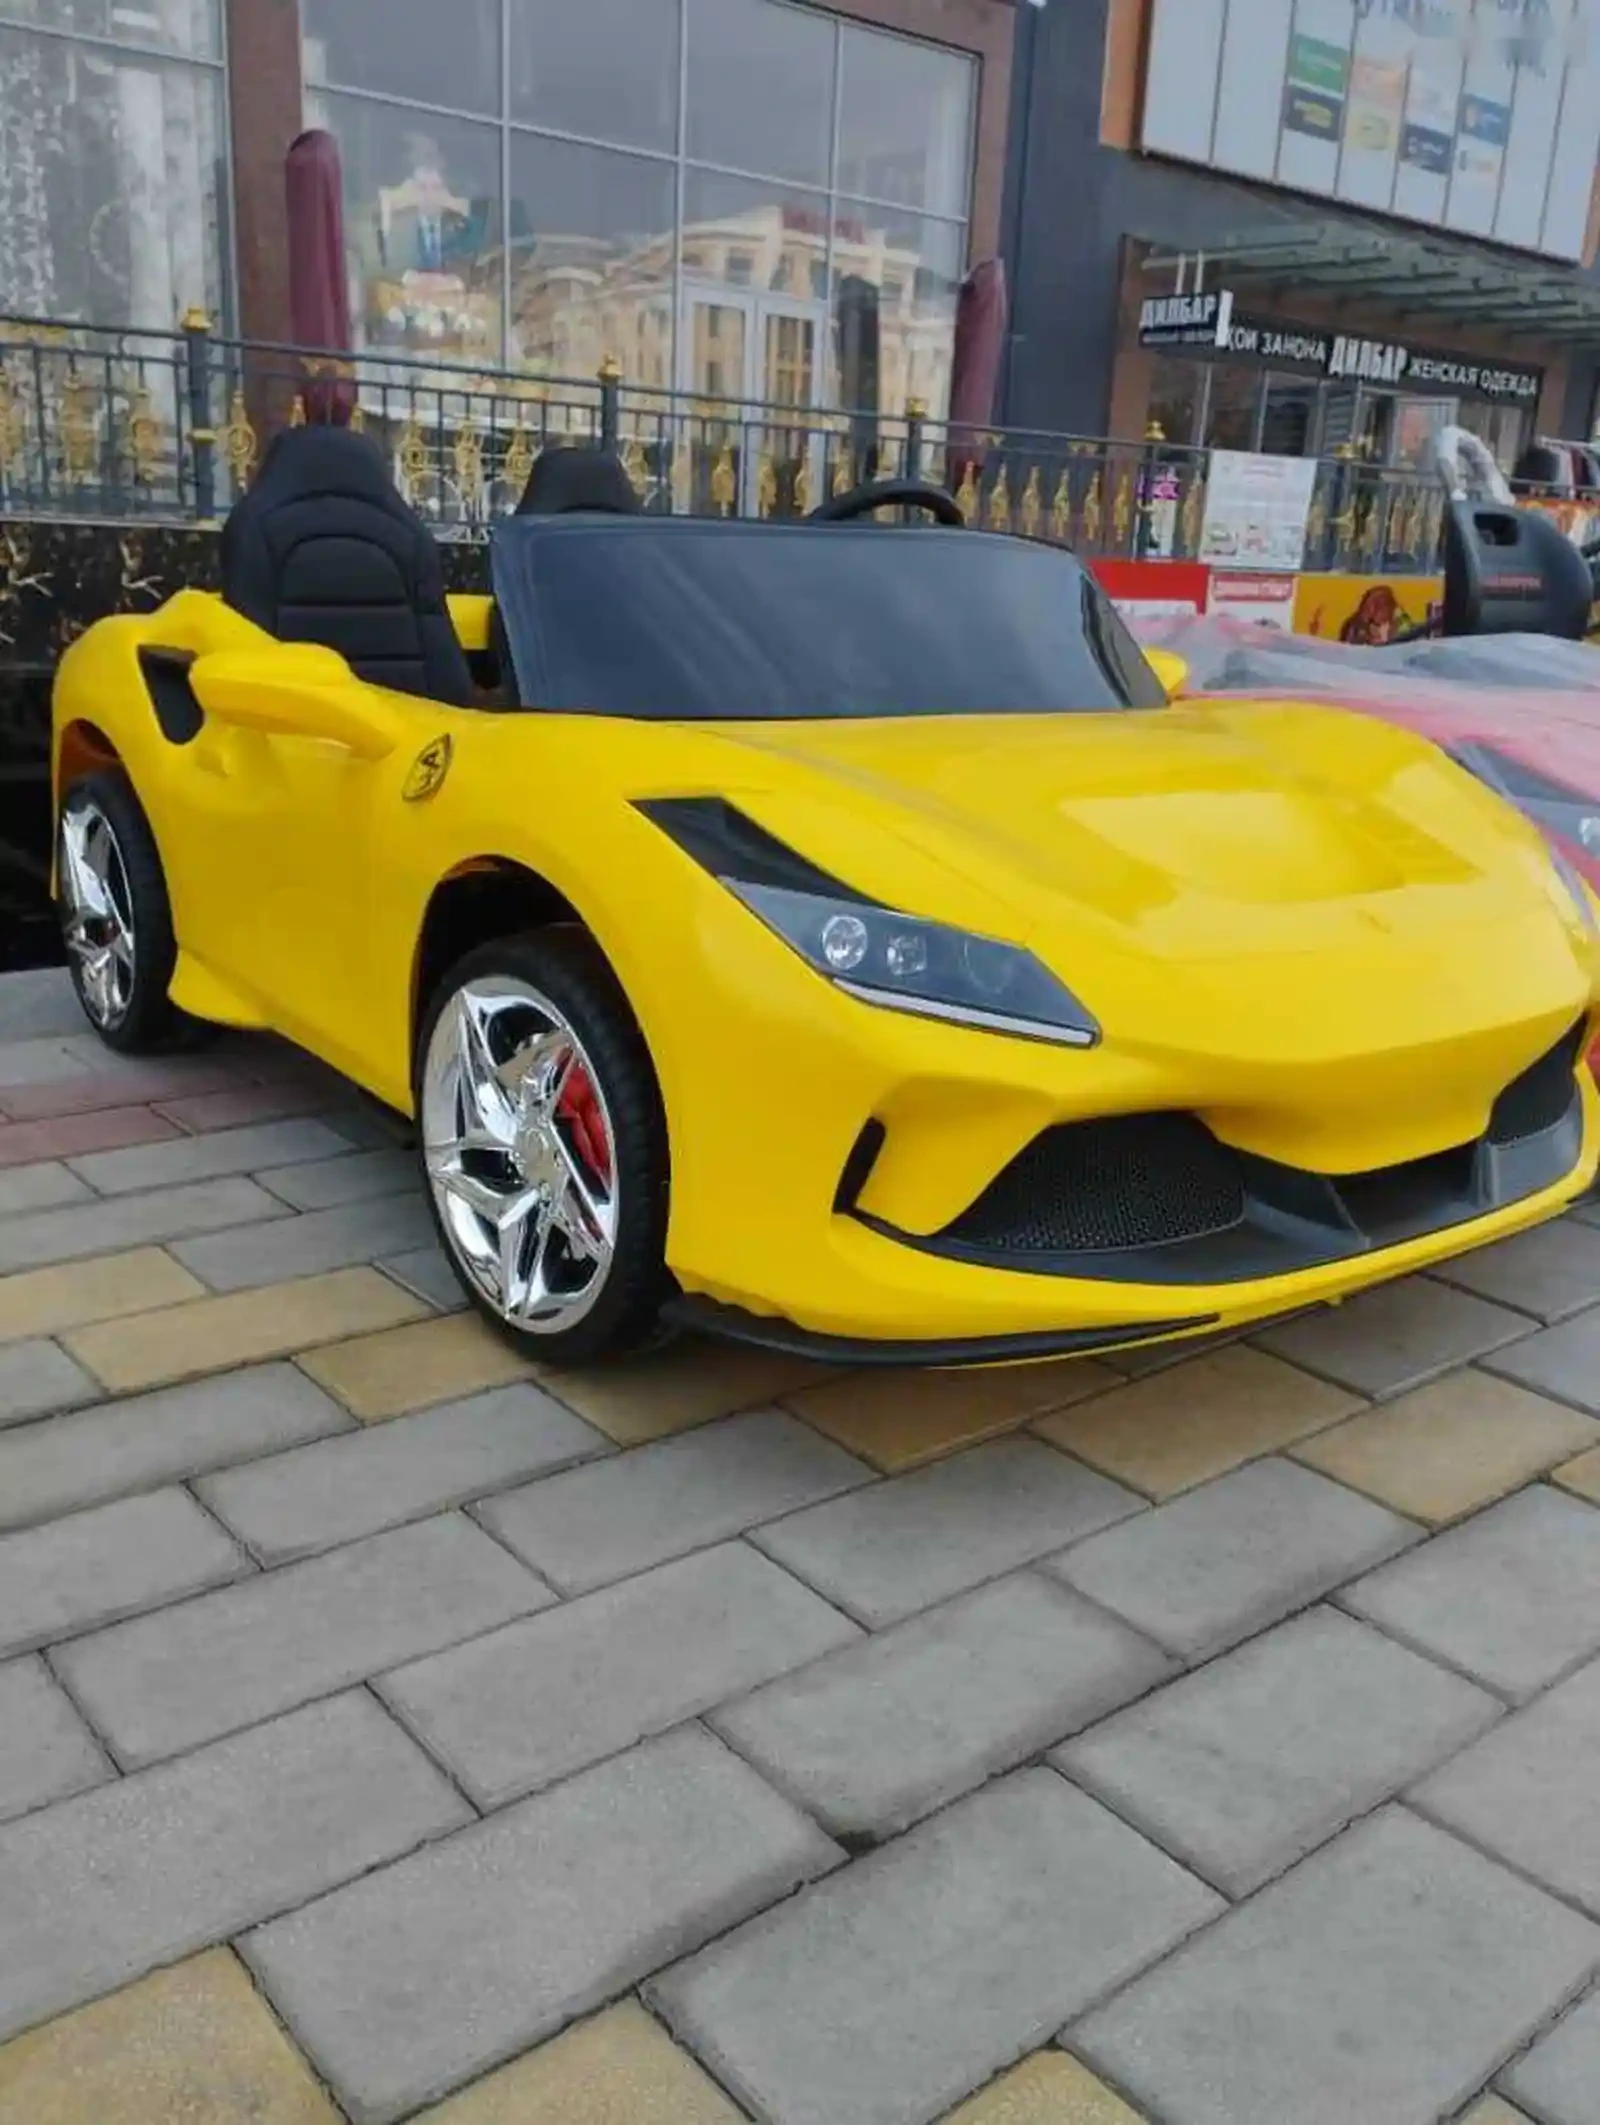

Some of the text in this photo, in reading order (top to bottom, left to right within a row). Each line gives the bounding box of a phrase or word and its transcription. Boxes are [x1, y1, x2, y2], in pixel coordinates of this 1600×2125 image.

[1139, 295, 1216, 328] ДИЛБАР
[1328, 336, 1408, 384] ДИЛБАР
[1408, 356, 1479, 386] ЖЕНСКАЯ
[1480, 366, 1537, 397] ОДЕЖДА
